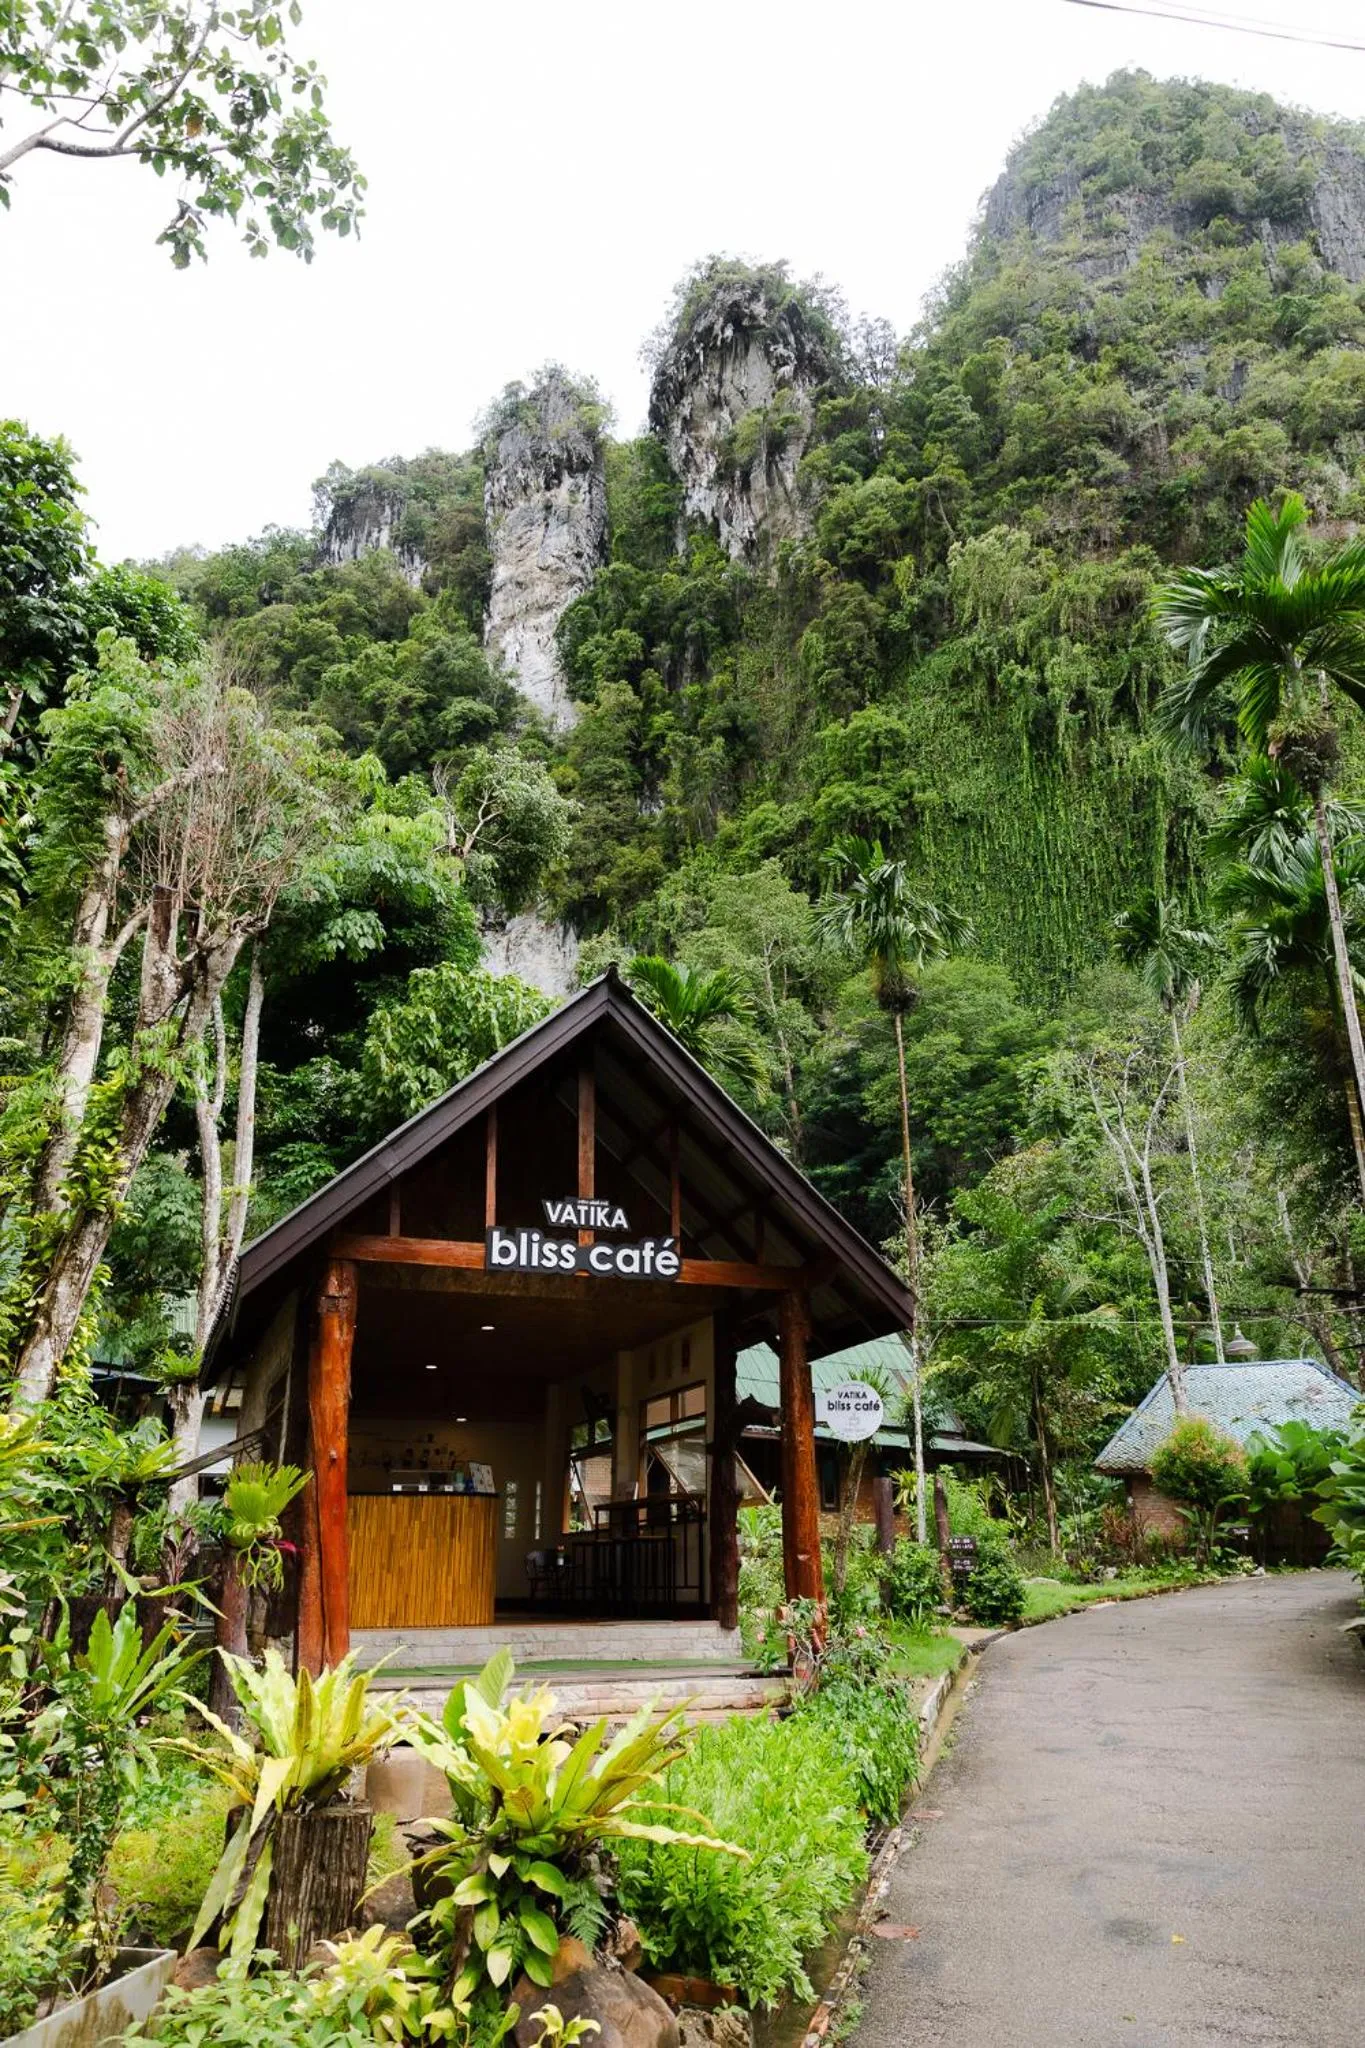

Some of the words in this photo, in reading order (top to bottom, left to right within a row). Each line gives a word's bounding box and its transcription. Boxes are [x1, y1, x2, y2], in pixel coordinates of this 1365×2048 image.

[545, 1202, 628, 1229] VATIKA
[491, 1231, 576, 1269] bliss
[589, 1238, 680, 1276] café
[837, 1391, 867, 1399] VATIKA
[827, 1400, 851, 1411] bliss
[854, 1400, 880, 1411] café
